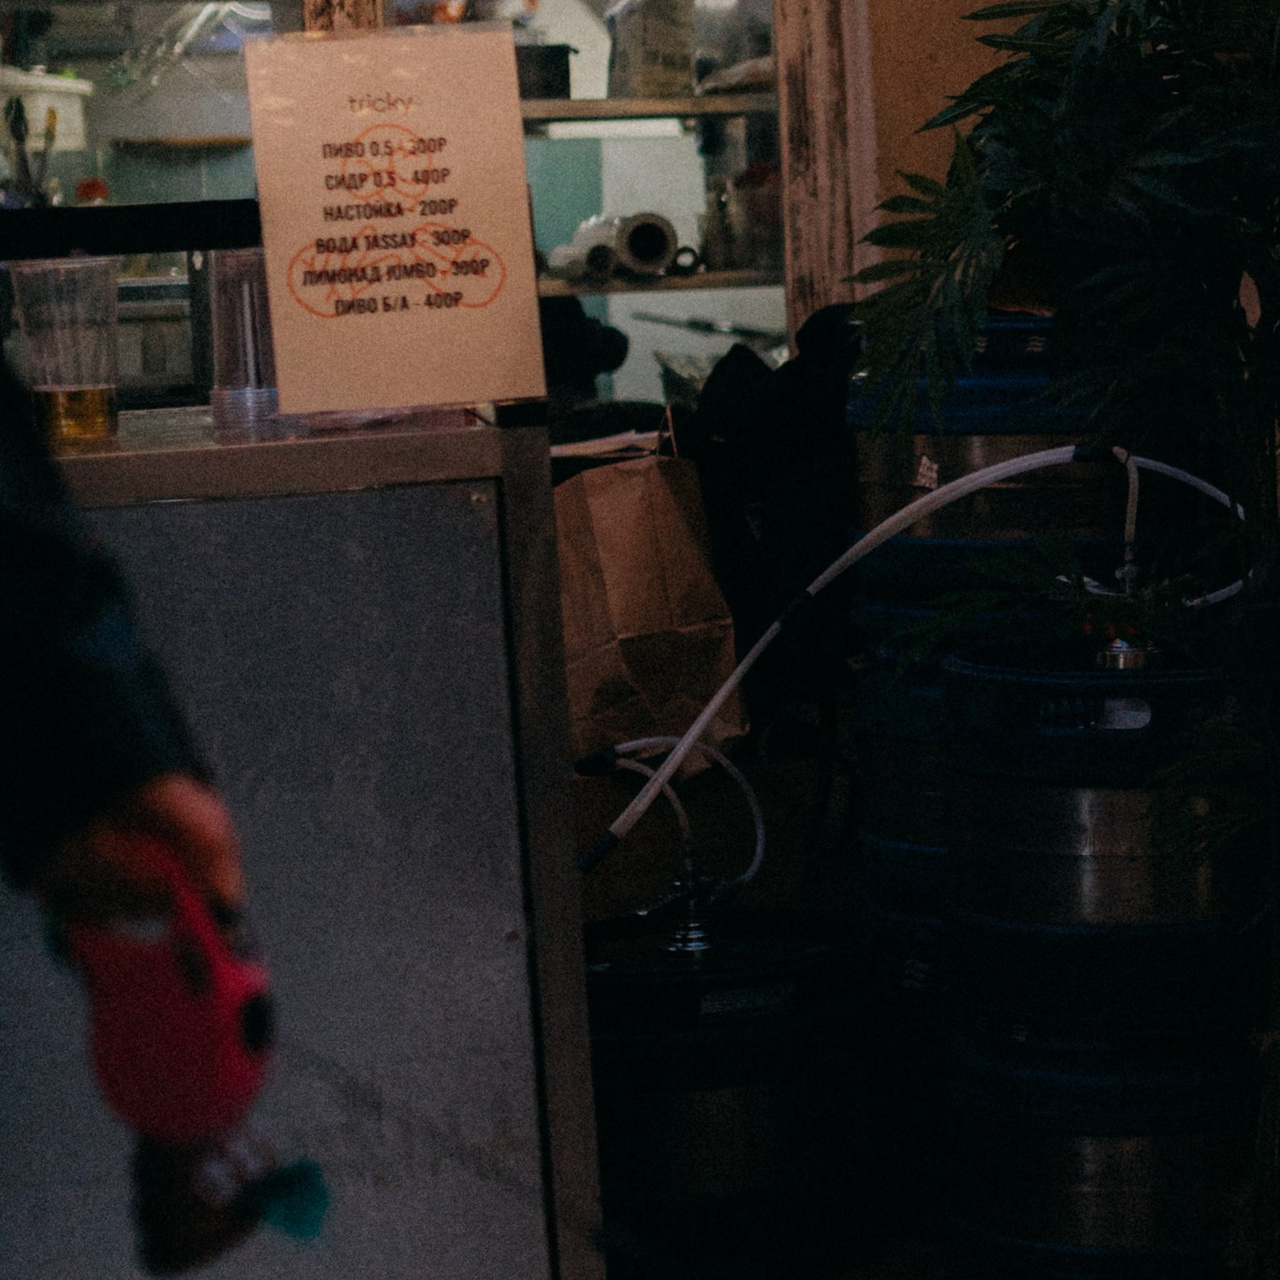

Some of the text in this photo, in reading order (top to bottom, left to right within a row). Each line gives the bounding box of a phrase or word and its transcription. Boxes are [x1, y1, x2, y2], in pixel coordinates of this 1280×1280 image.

[348, 91, 413, 116] tricky
[322, 141, 365, 159] ПИВО
[325, 172, 368, 191] СИДР
[323, 200, 404, 221] НАСТОЙКА
[315, 236, 359, 254] ВОДА
[302, 265, 382, 286] ЛИМОНАД
[334, 297, 379, 317] ПИВО
[382, 295, 410, 313] Б/А
